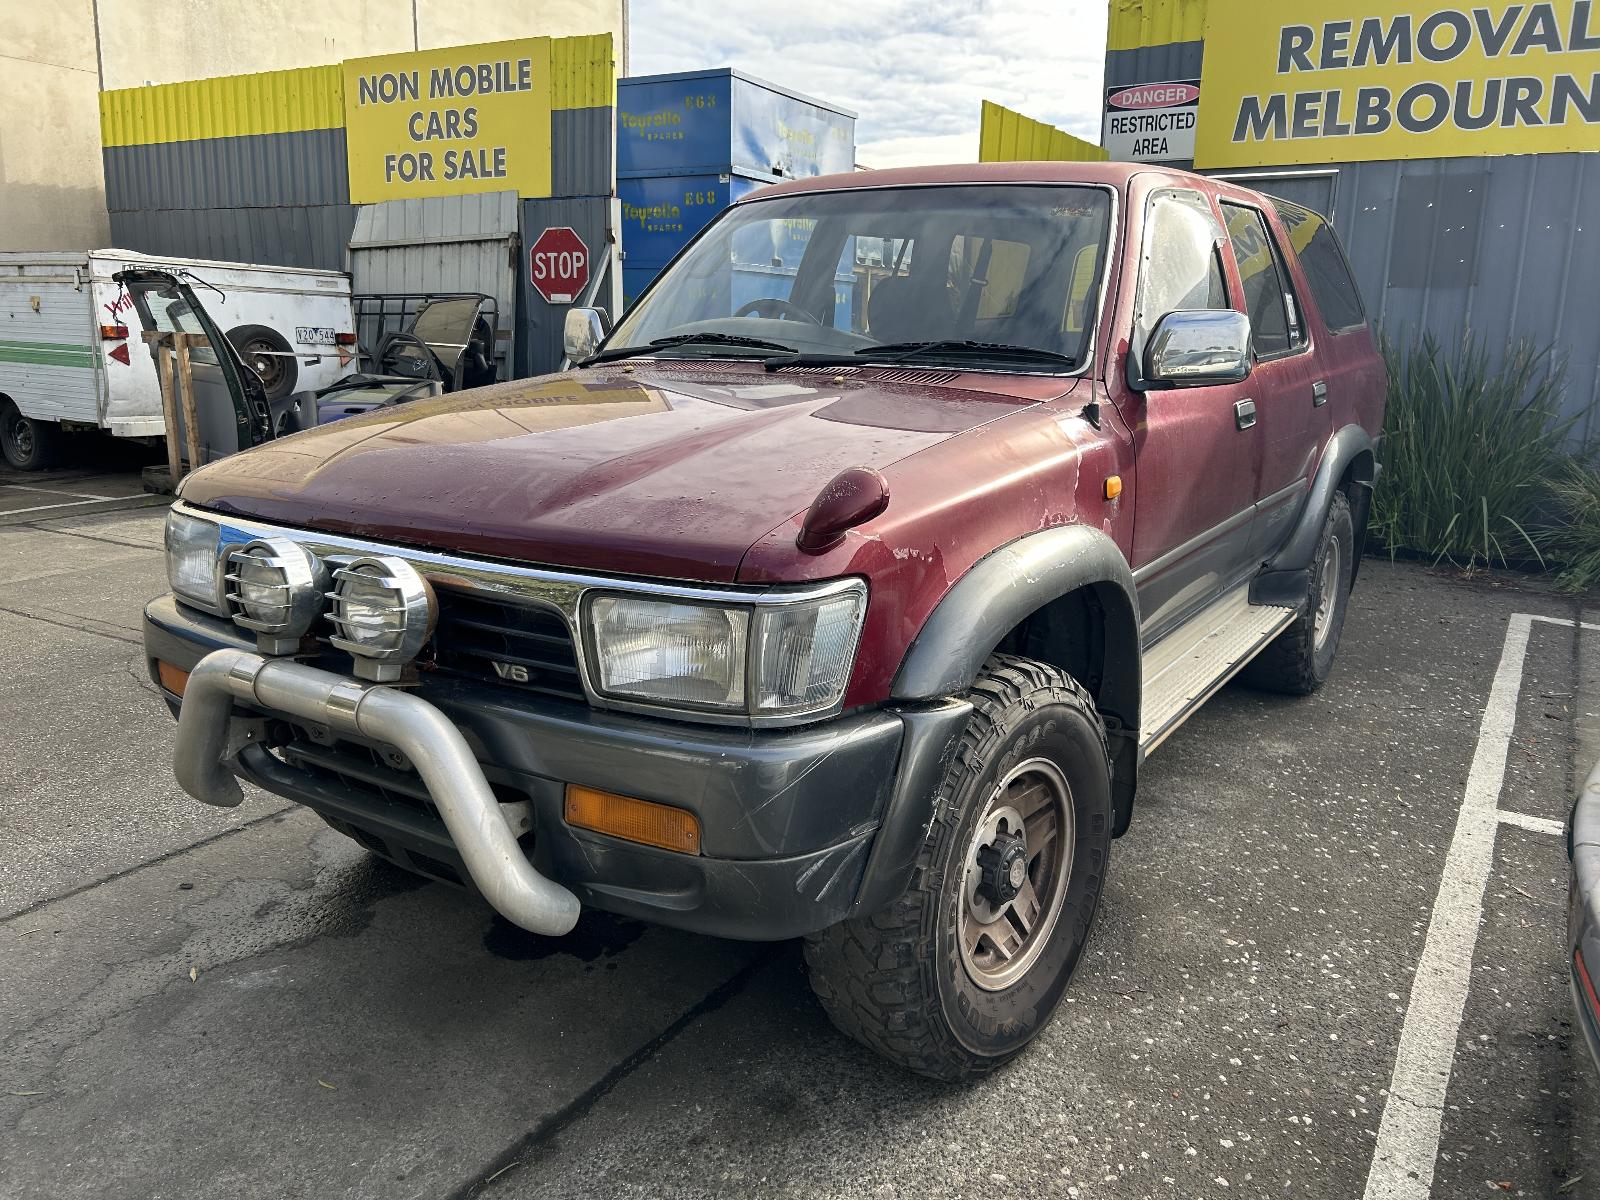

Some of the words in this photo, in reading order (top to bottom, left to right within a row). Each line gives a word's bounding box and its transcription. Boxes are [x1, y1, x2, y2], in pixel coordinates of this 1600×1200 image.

[359, 71, 420, 106] NON
[429, 58, 532, 99] MOBILE
[1122, 88, 1187, 105] DANGER
[408, 107, 479, 142] CARS
[1111, 112, 1196, 135] RESTRICTED
[1132, 137, 1169, 156] AREA
[384, 152, 436, 183] FOR
[443, 147, 507, 181] SALE
[534, 251, 585, 280] STOP
[319, 330, 335, 341] 544
[491, 661, 529, 682] V6
